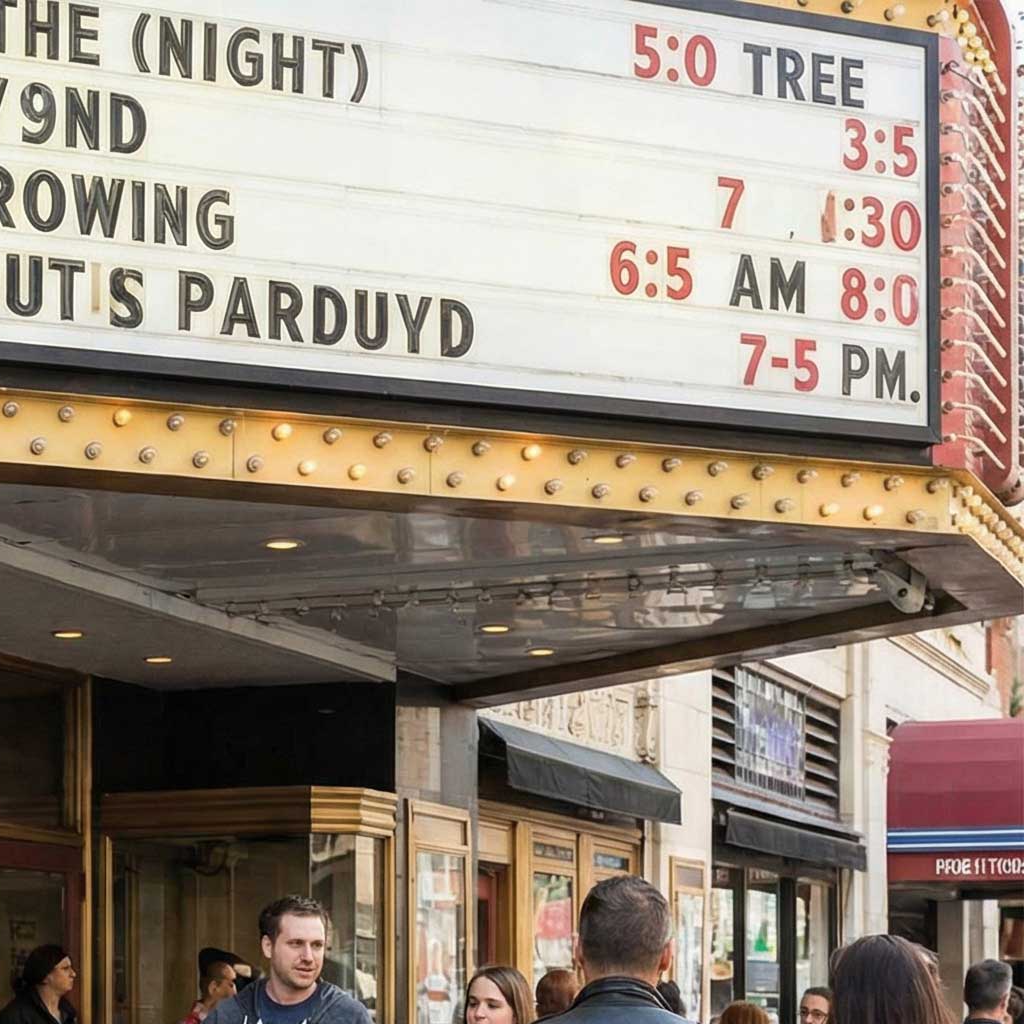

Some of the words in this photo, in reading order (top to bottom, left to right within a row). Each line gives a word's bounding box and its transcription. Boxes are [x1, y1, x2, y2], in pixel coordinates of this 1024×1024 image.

[132, 13, 369, 103] (NIGHT)
[634, 24, 718, 87] 5:0
[743, 42, 865, 109] TREE
[843, 118, 918, 177] 3:5
[718, 176, 745, 229] 7
[178, 270, 474, 358] PARDUYD
[610, 240, 694, 301] 6:5
[729, 254, 806, 314] AM
[841, 267, 919, 326] 8:0
[740, 333, 819, 392] 7-5
